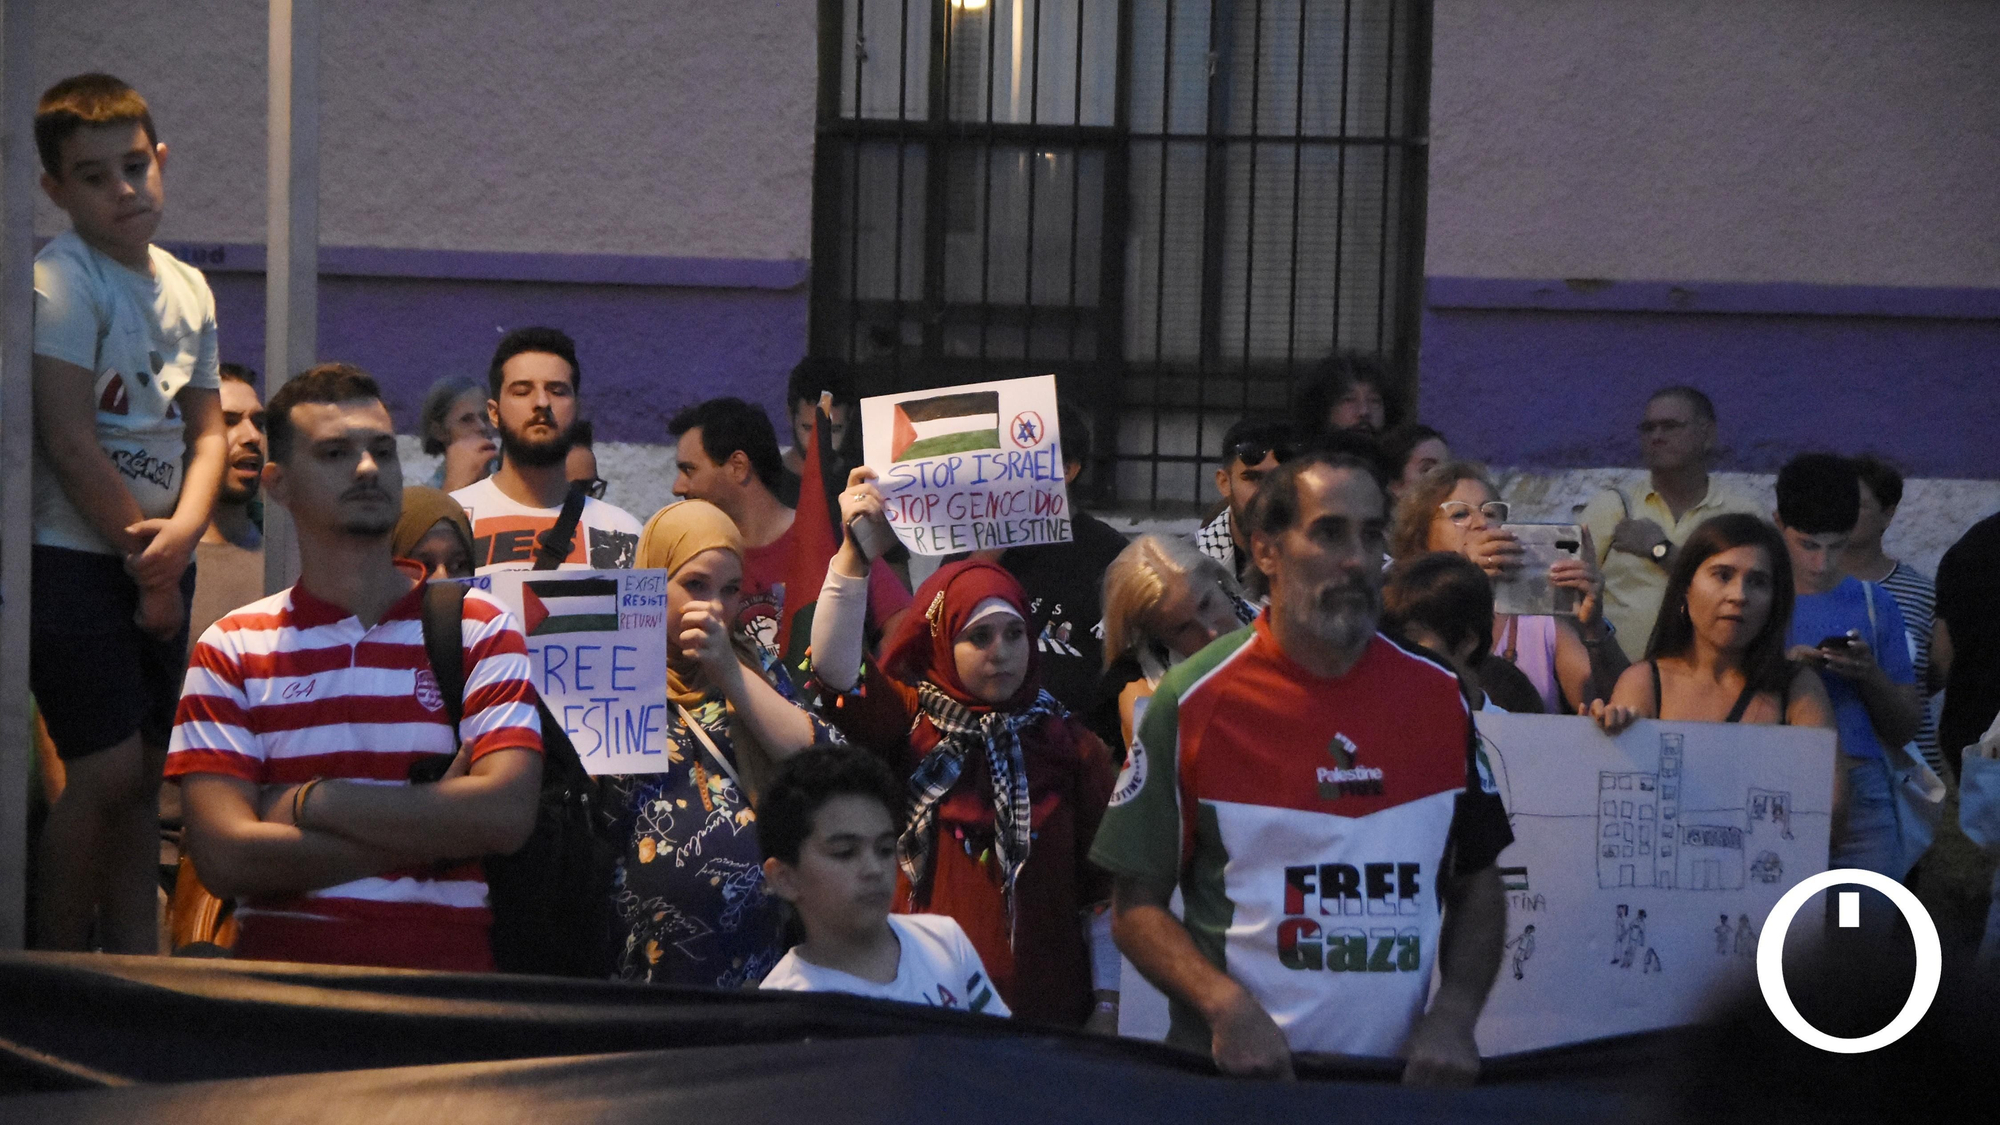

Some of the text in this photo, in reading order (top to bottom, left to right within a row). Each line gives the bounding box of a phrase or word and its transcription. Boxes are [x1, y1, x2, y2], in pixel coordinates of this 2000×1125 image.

[888, 443, 1064, 492] STOP ISRAEL
[883, 492, 940, 523] STOP
[972, 518, 1070, 549] PALESTINE
[620, 613, 663, 630] RETURN!
[564, 698, 665, 758] ESTINE
[1316, 765, 1384, 783] Palestine
[1284, 862, 1421, 916] FREE
[1277, 918, 1421, 972] Gaza
